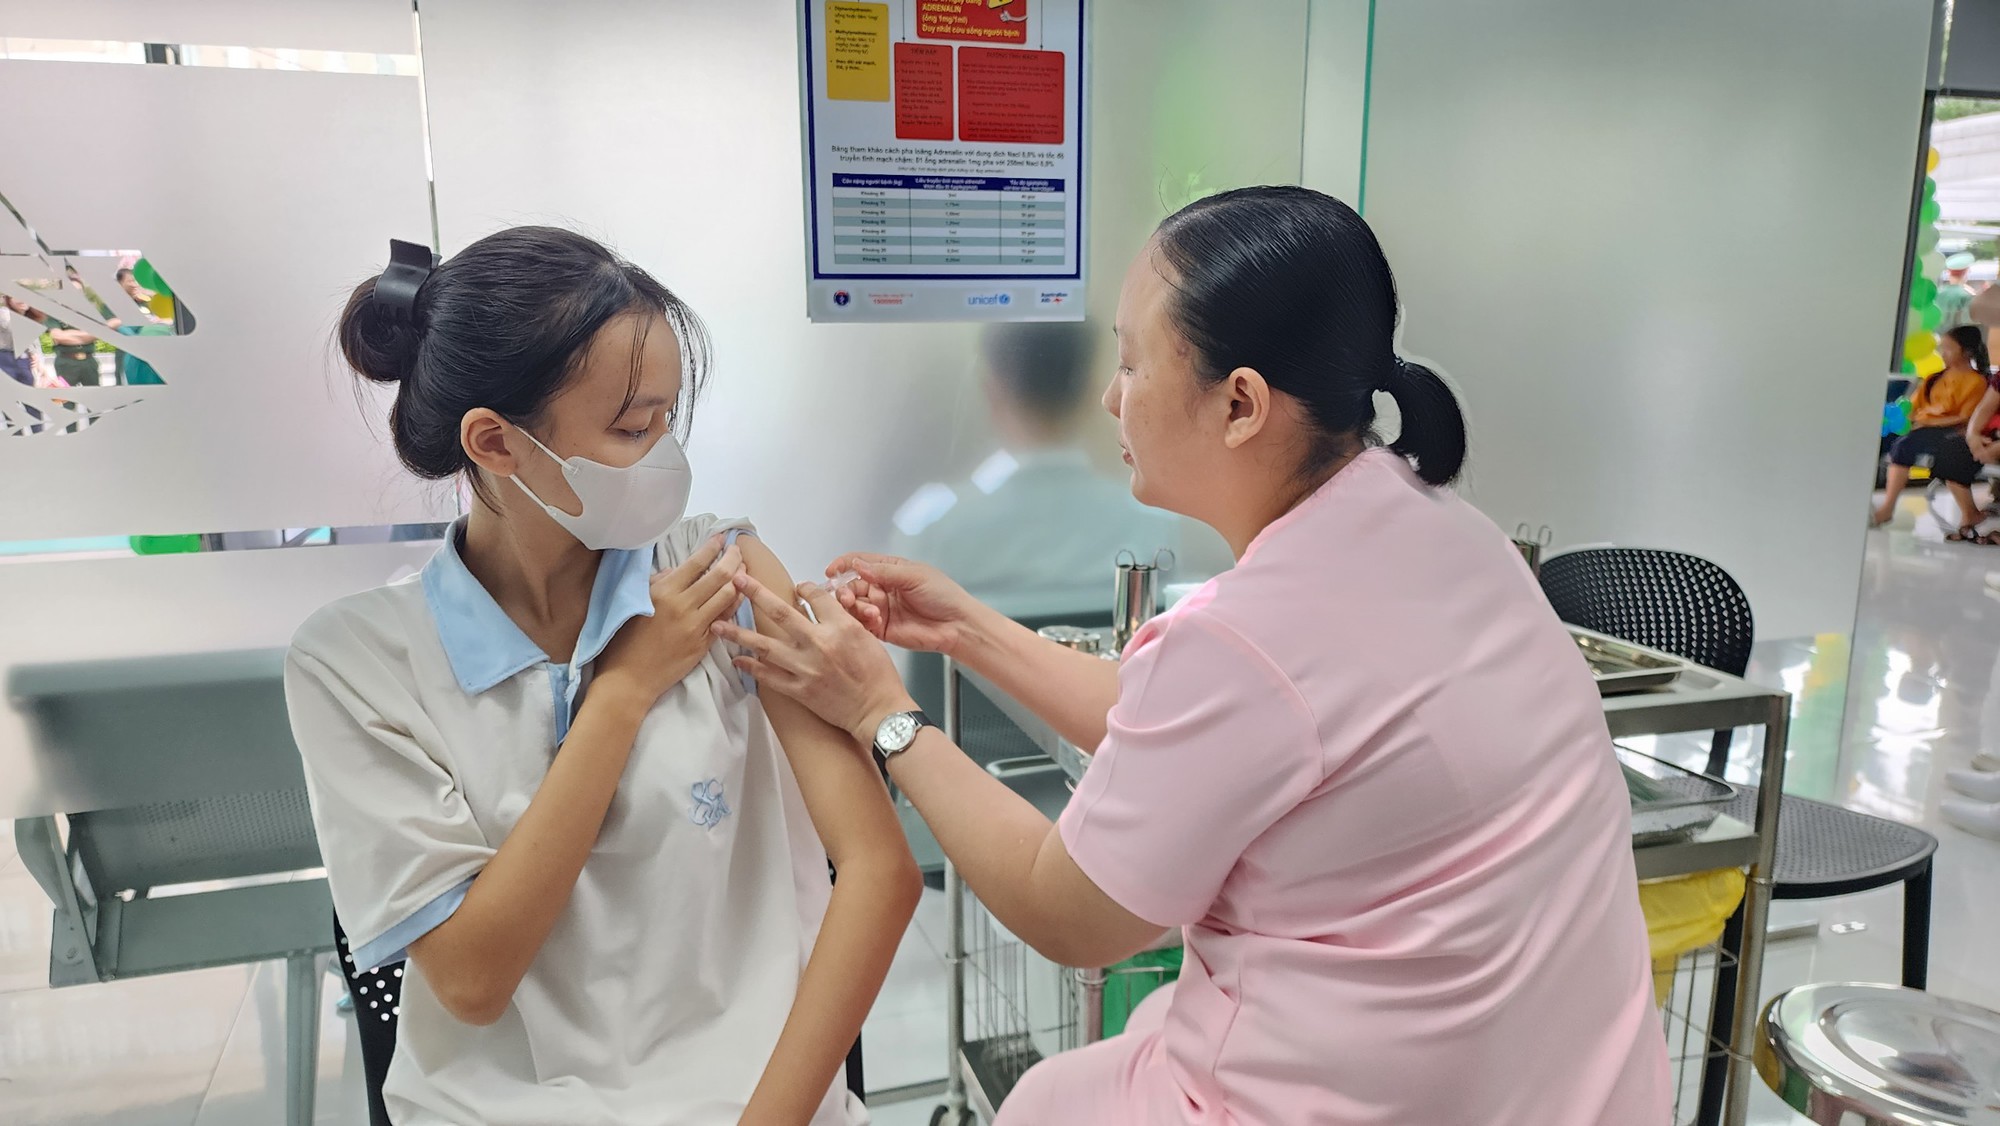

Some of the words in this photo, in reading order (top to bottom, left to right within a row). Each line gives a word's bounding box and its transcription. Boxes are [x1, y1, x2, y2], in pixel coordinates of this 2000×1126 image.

[922, 3, 962, 13] ADRENALIN
[922, 24, 935, 33] Duy
[967, 294, 998, 305] unicef
